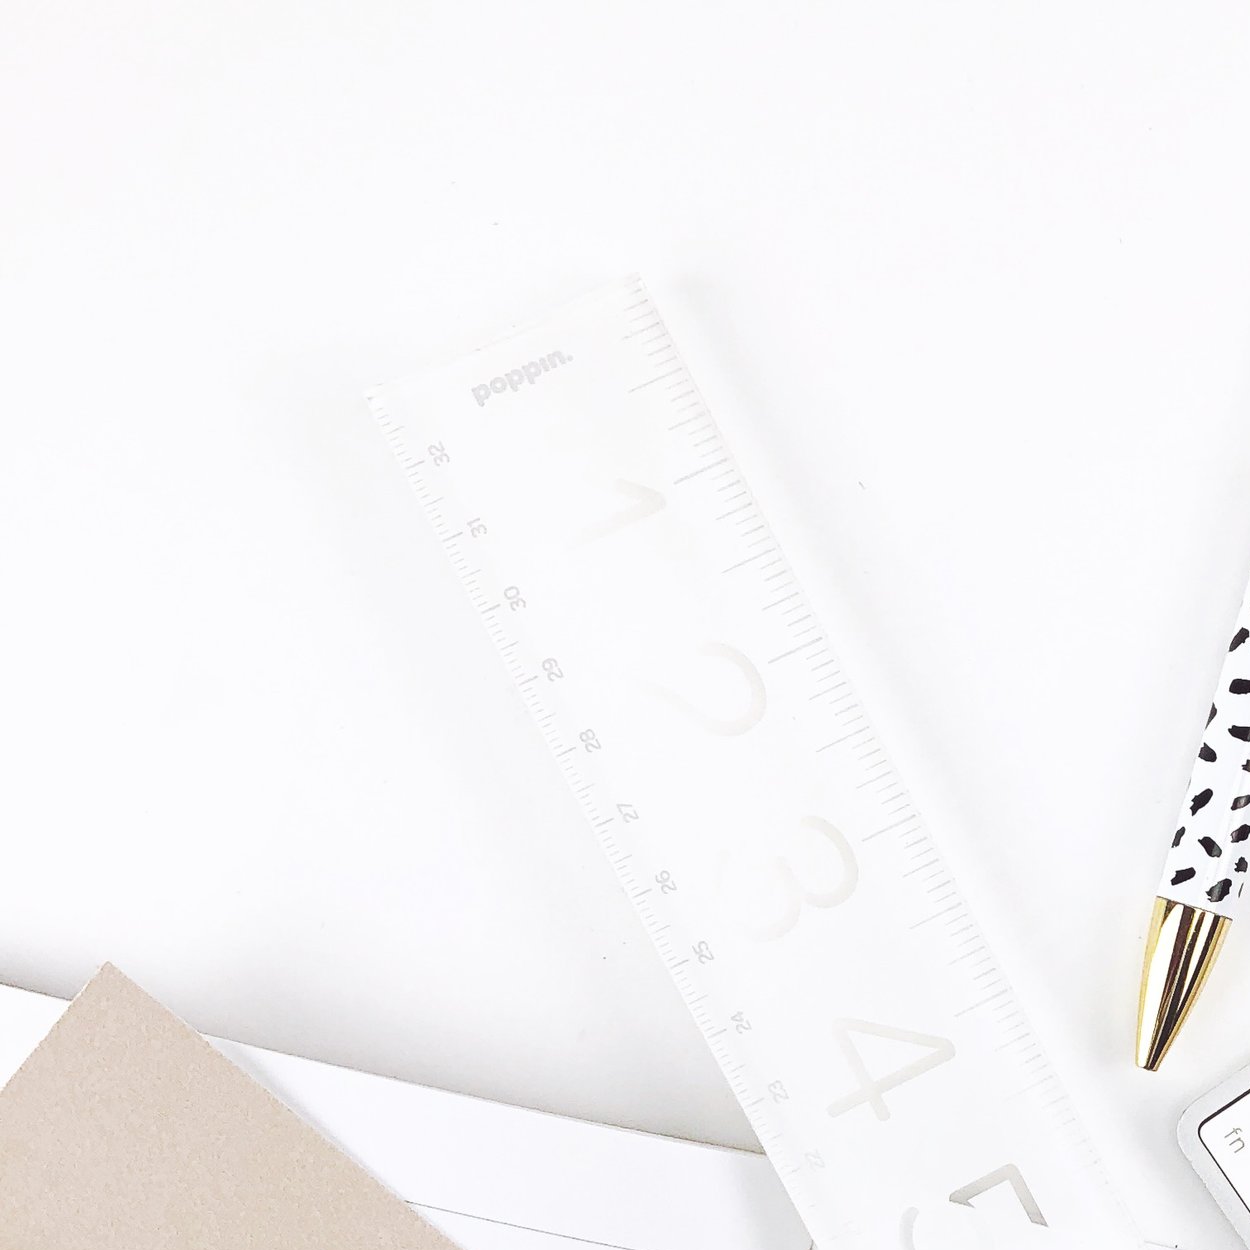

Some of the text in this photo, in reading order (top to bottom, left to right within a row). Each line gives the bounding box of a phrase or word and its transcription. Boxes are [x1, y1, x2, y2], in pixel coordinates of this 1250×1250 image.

[426, 440, 451, 468] 32
[465, 516, 488, 539] 31
[502, 584, 527, 613] 30
[540, 657, 565, 683] 29
[578, 727, 603, 754] 28
[615, 802, 641, 824] 27
[653, 869, 678, 896] 26
[716, 815, 859, 942] 3
[691, 939, 716, 966] 25
[729, 1010, 753, 1035] 24
[825, 1017, 955, 1121] 4
[1223, 1126, 1247, 1155] fn
